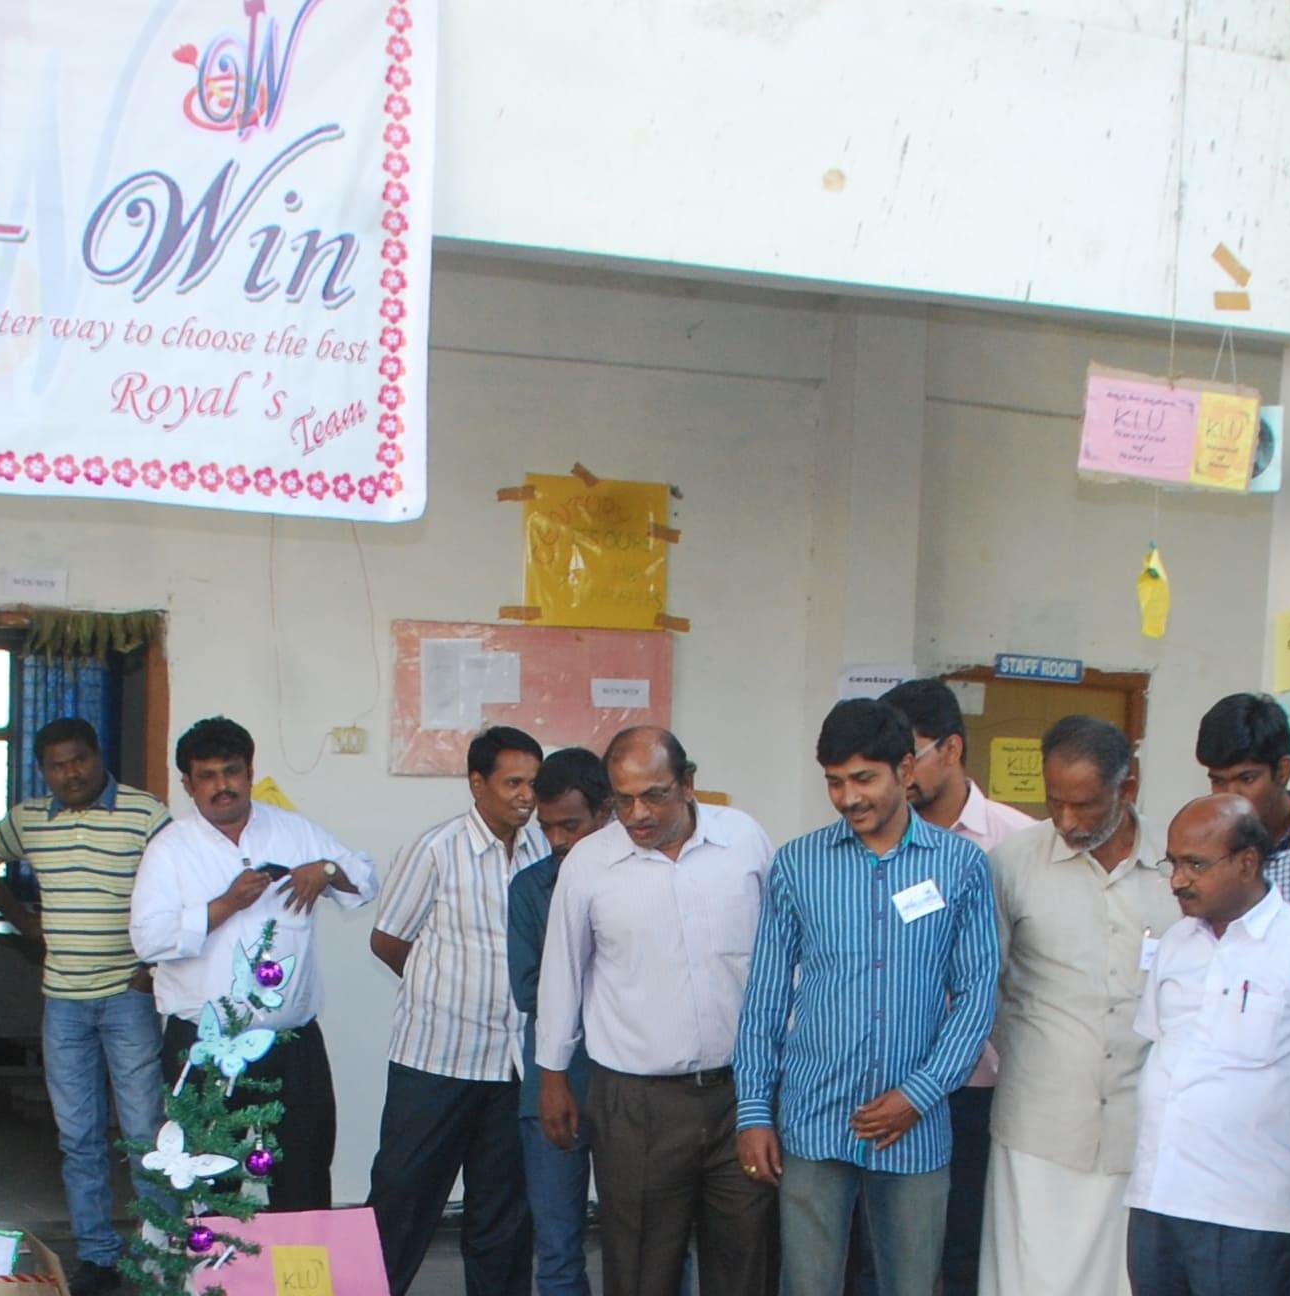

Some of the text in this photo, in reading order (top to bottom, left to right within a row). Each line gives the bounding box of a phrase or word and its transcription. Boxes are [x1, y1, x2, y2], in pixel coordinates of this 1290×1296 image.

[82, 124, 360, 310] Win
[50, 318, 111, 352] way
[124, 319, 153, 345] to
[161, 316, 255, 355] choose
[264, 325, 309, 358] the
[316, 326, 370, 363] best
[290, 399, 367, 456] Team
[1000, 656, 1077, 679] STAFF ROOM
